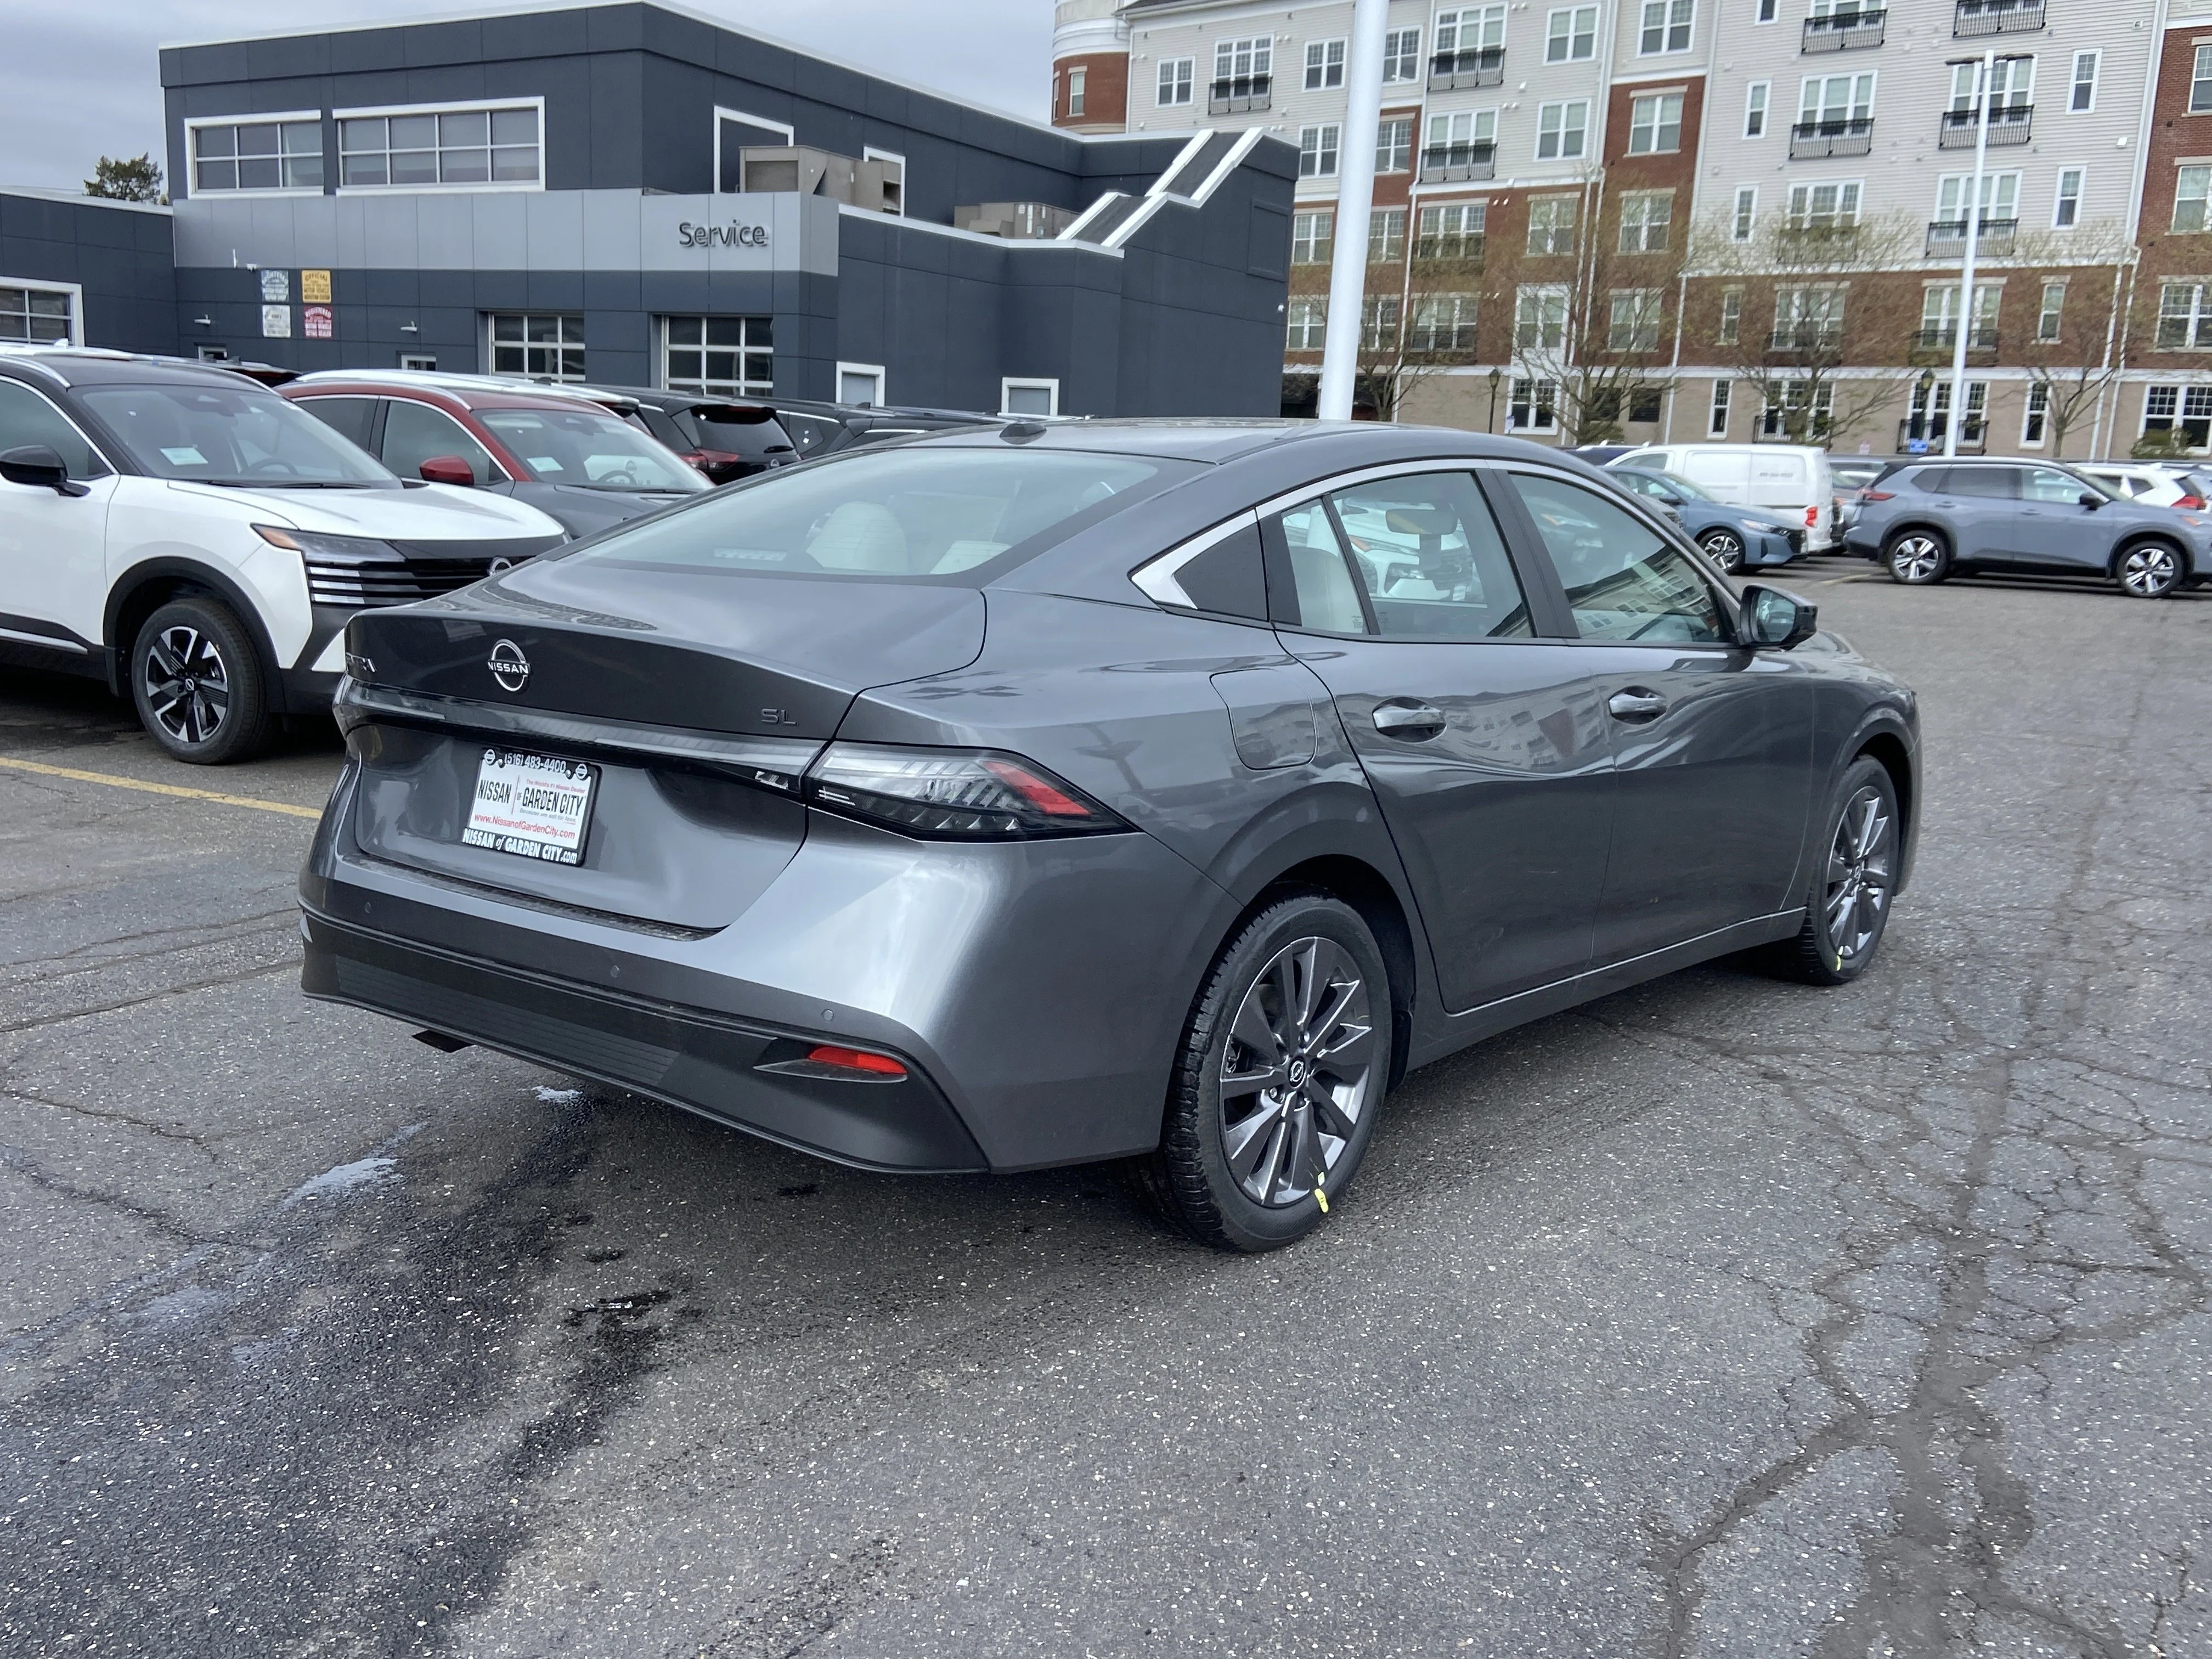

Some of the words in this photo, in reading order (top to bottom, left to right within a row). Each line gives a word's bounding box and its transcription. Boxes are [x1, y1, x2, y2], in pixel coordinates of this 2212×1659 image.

[679, 219, 766, 245] Service
[304, 272, 328, 282] OFFICIAL
[488, 661, 529, 674] NISSAN
[761, 708, 797, 725] SL
[505, 753, 524, 766] (516)
[524, 755, 567, 774] 483-4400
[477, 779, 512, 804] NISSAN
[522, 787, 560, 812] GARDEN
[560, 793, 584, 816] CITY
[474, 814, 575, 839] www.NissanofGardenCity.com
[462, 828, 495, 848] NISSAN
[496, 836, 506, 850] of
[505, 837, 541, 857] GARDEN
[542, 845, 578, 864] CITY.com
